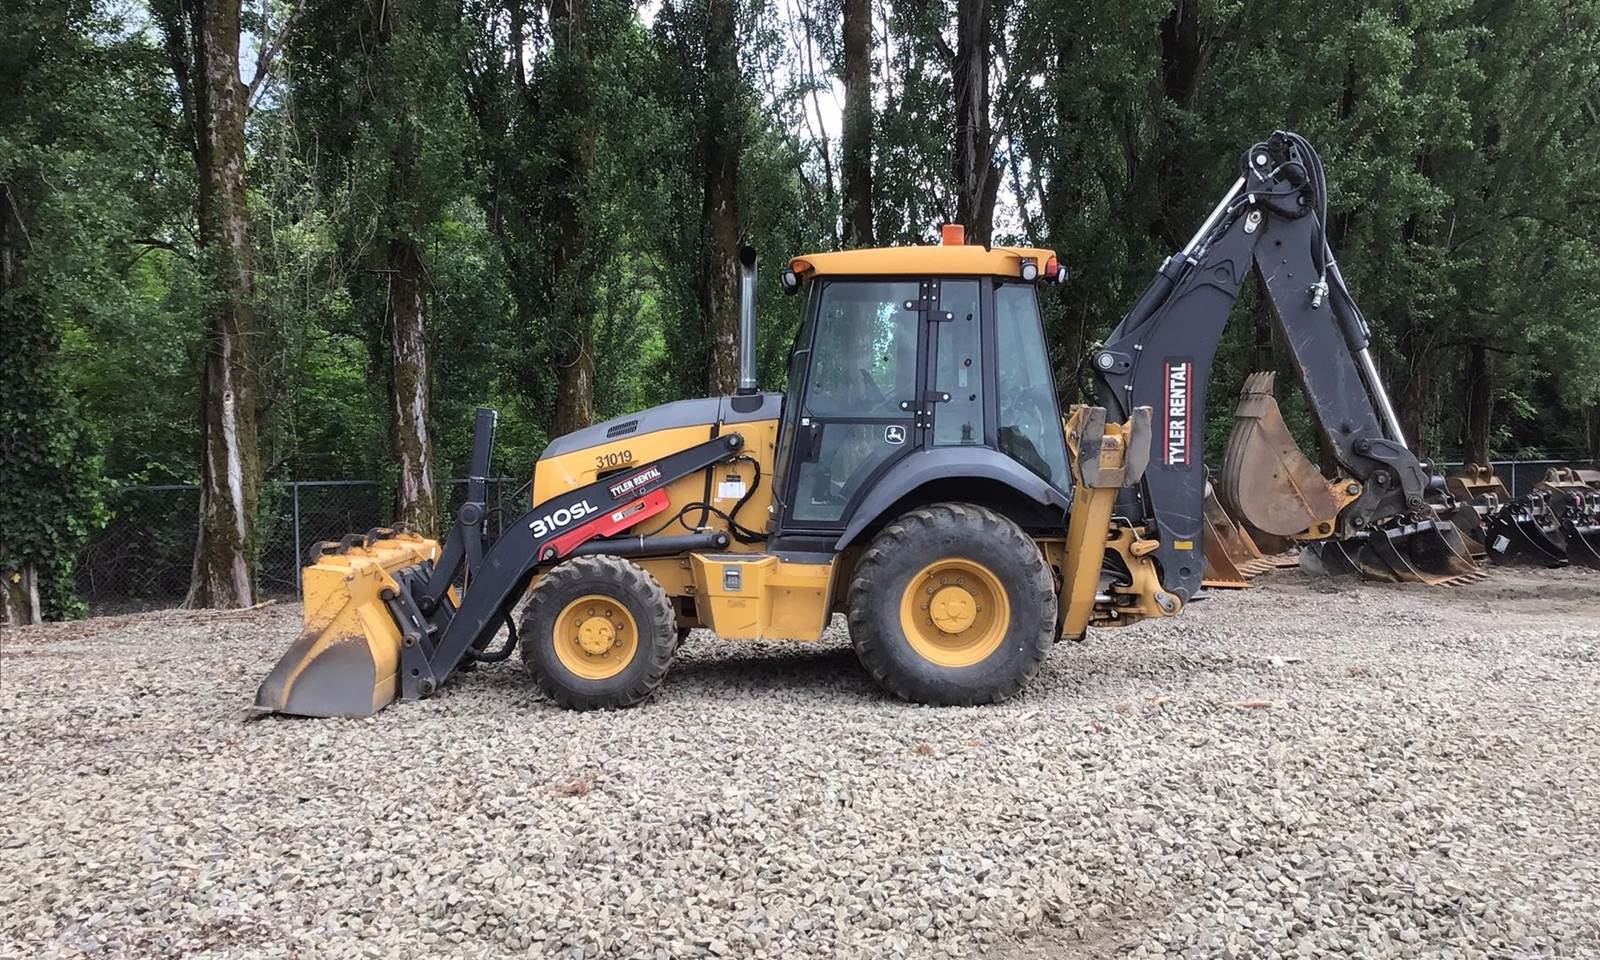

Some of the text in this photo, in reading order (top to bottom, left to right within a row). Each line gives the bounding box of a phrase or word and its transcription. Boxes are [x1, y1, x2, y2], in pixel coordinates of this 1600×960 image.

[1169, 363, 1187, 465] TYLER RENTAL
[596, 450, 632, 469] 31019
[610, 468, 660, 497] TYLER RENTAL
[529, 500, 598, 538] 310SL
